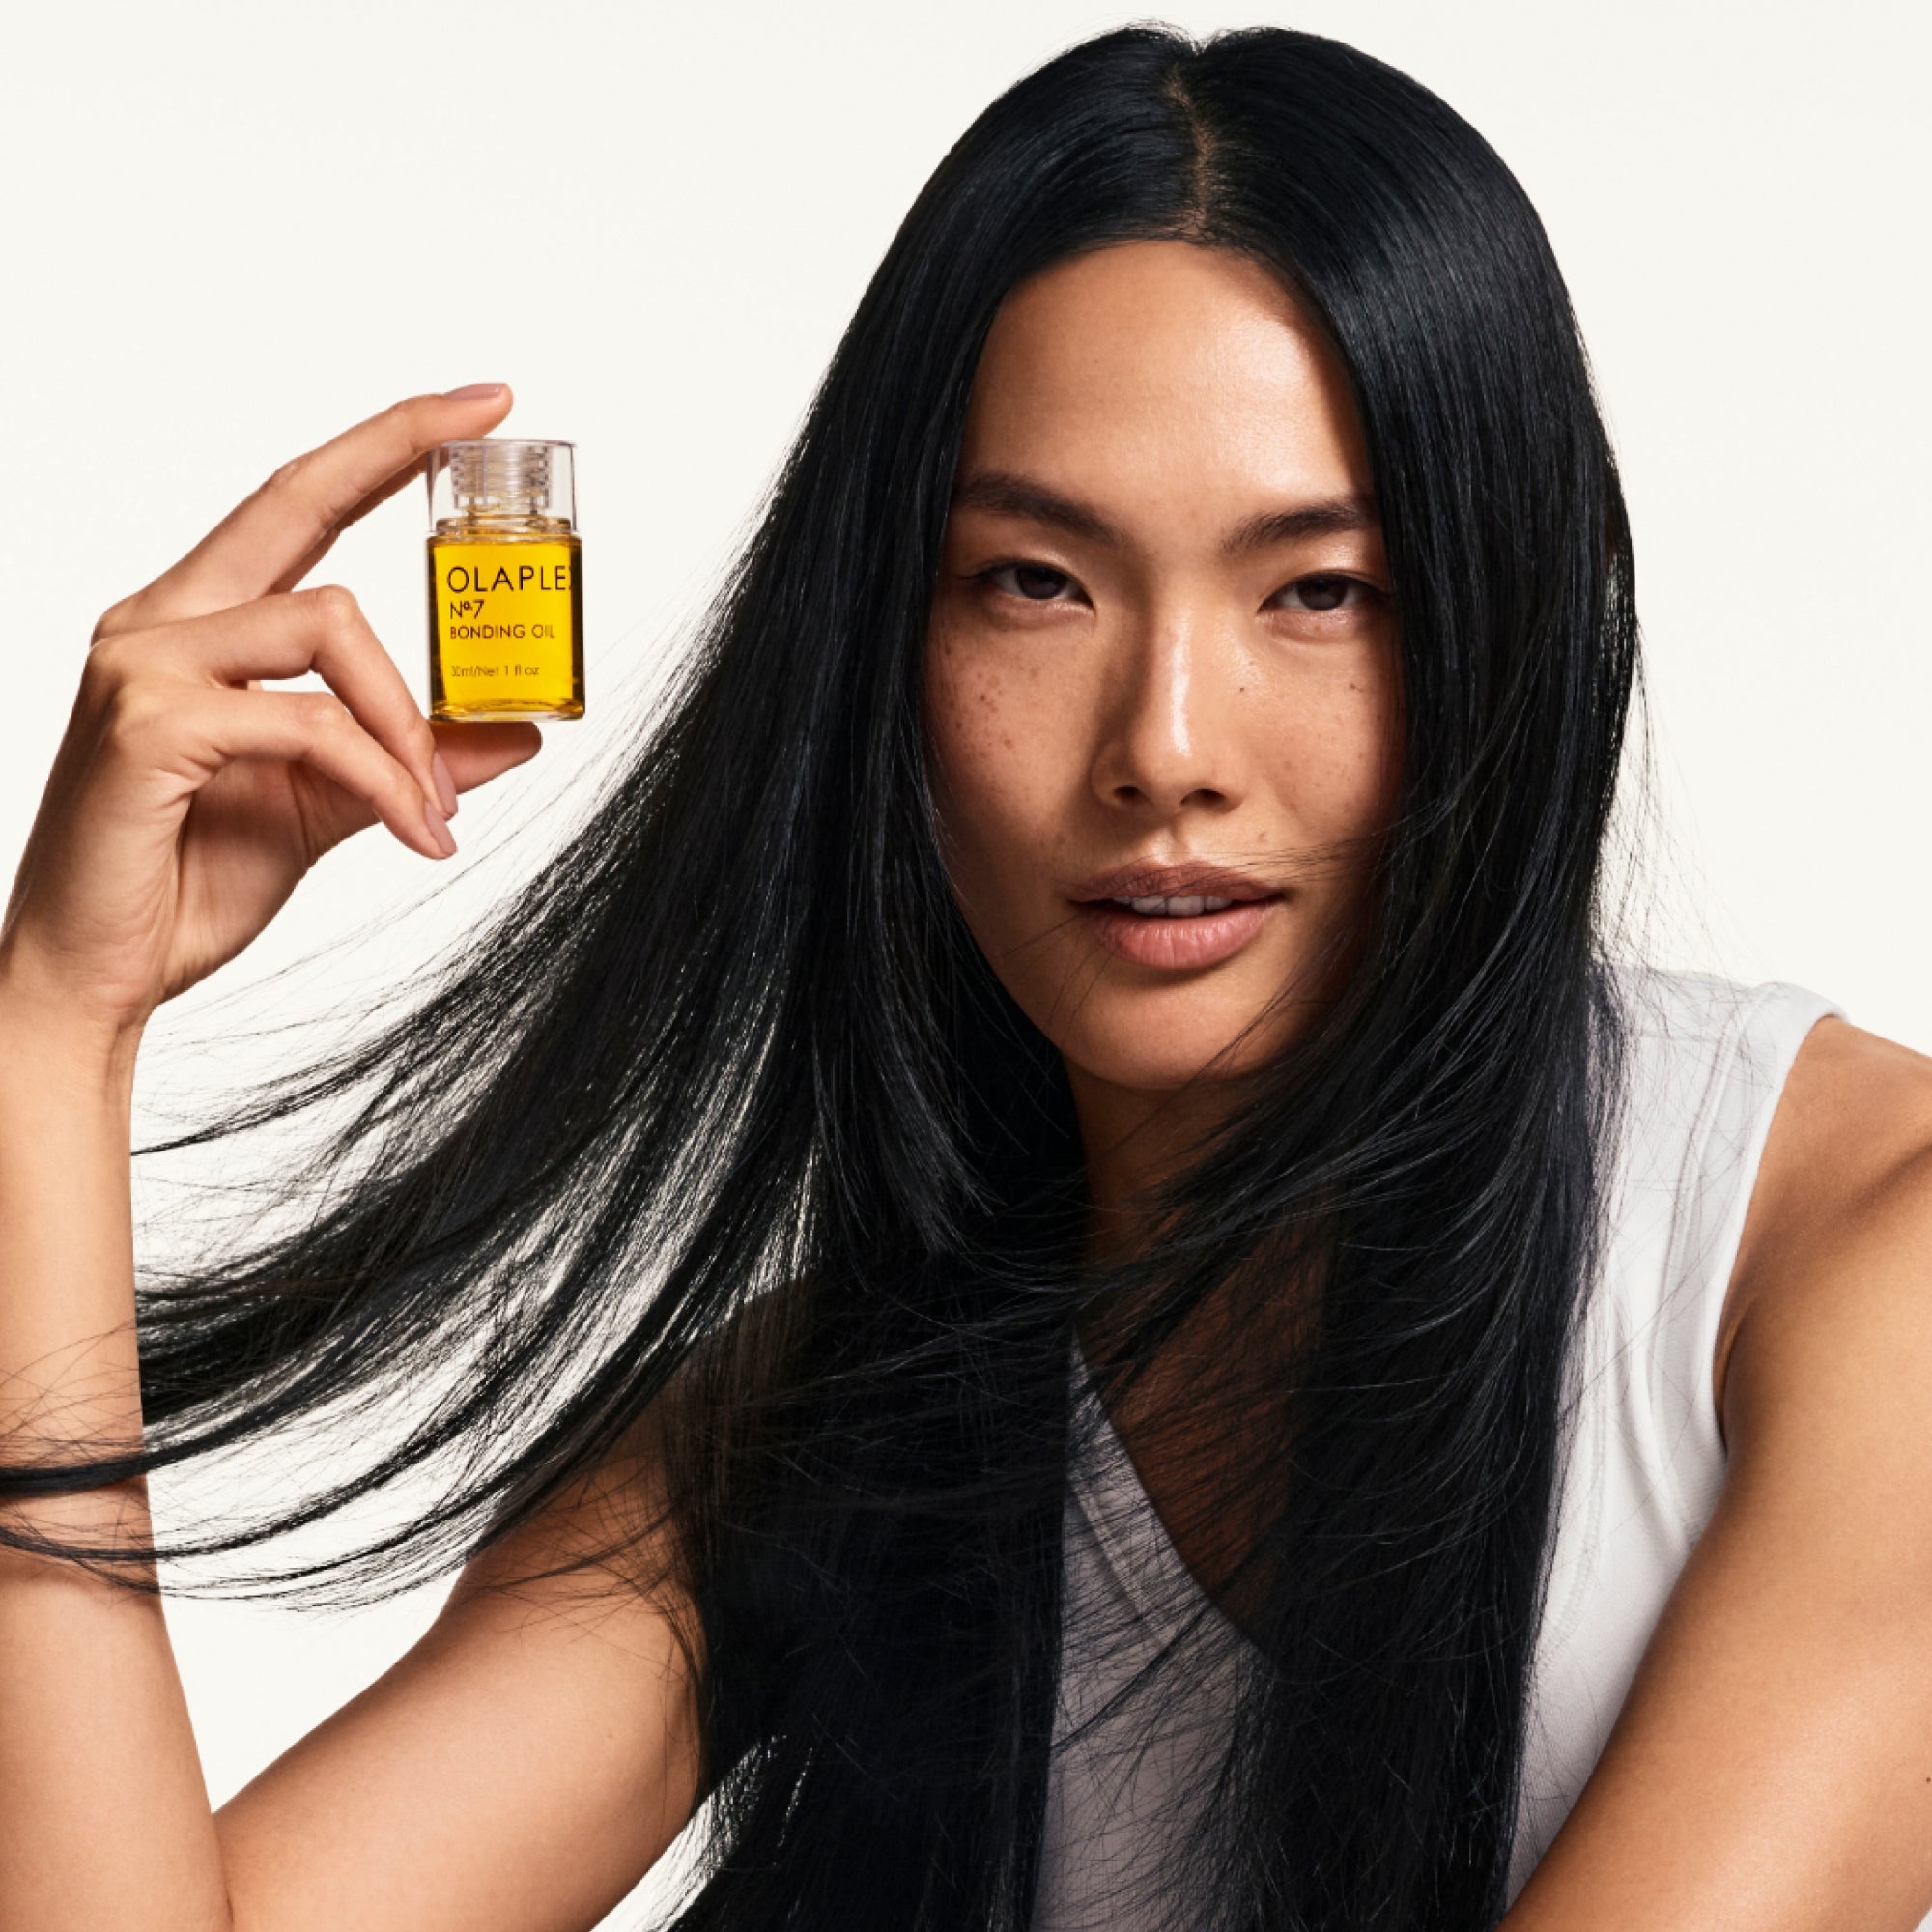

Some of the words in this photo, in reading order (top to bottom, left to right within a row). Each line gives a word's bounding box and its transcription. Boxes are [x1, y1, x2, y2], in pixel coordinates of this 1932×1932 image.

[447, 565, 572, 593] OLAPLE
[450, 624, 526, 639] BONDING
[531, 624, 555, 639] OIL
[503, 665, 509, 676] 1
[514, 664, 522, 676] fl
[524, 666, 540, 676] oz
